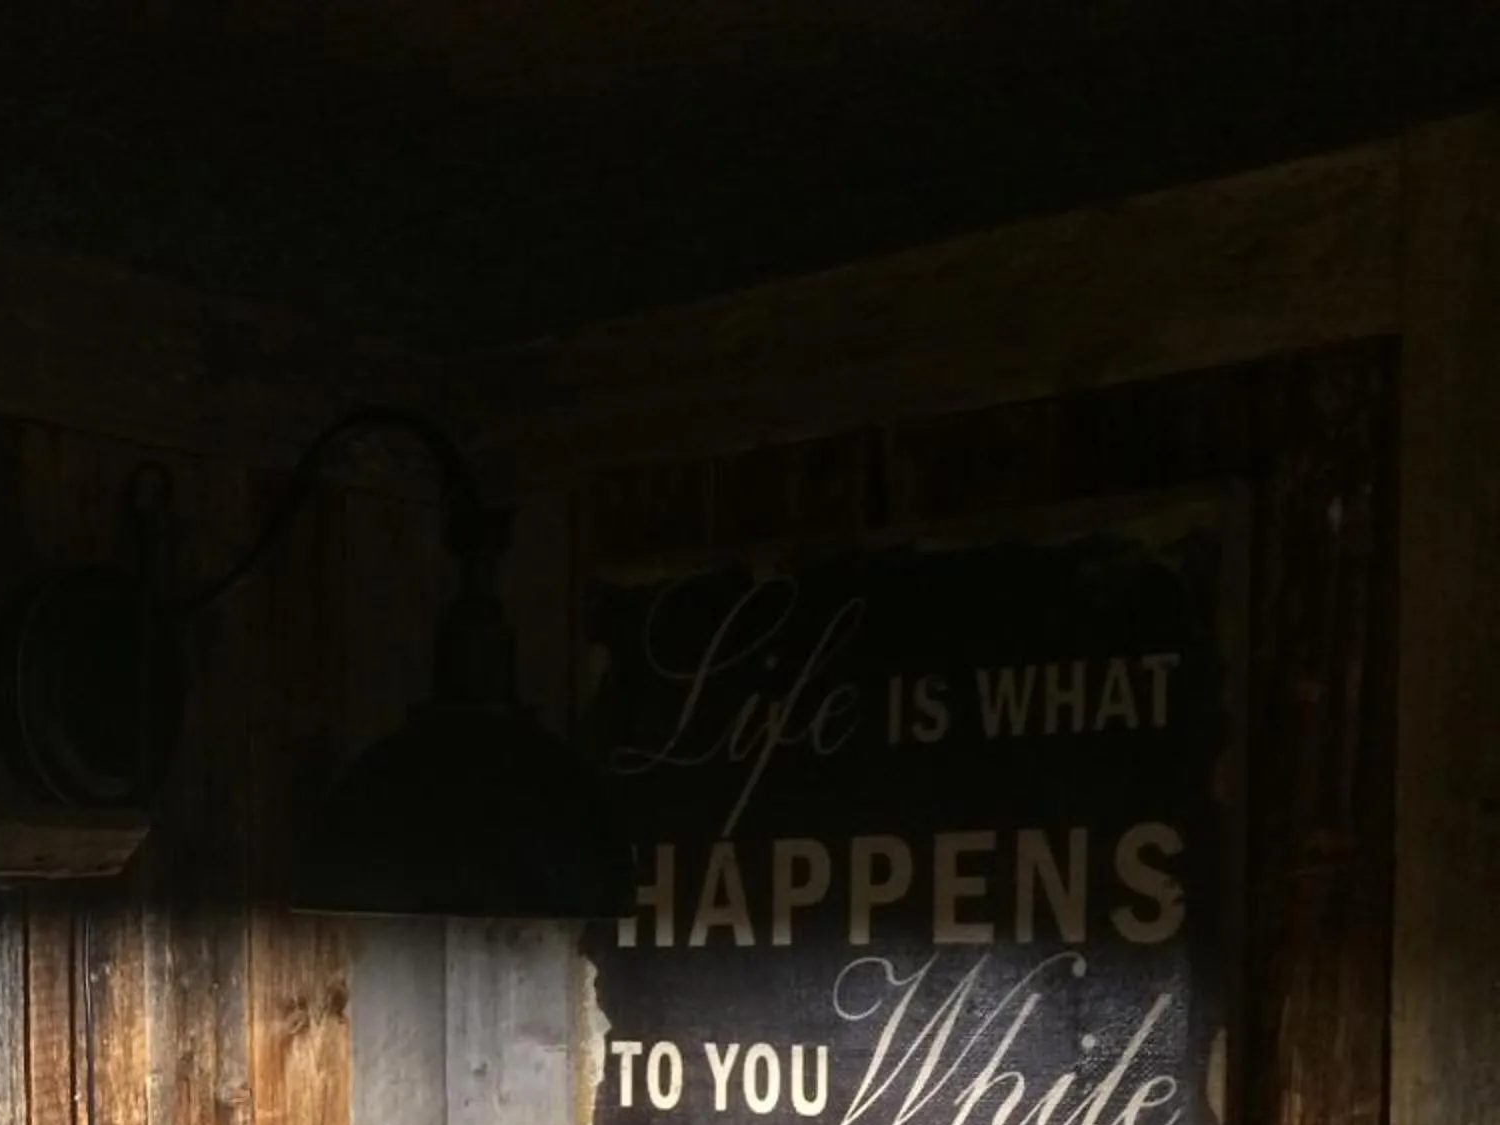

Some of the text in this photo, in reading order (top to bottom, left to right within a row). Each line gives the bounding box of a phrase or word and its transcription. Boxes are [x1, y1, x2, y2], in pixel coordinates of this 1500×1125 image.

[609, 575, 1181, 837] Life IS WHAT
[617, 821, 1186, 946] HAPPENS
[612, 1041, 681, 1110] TO
[705, 1043, 828, 1116] YOU
